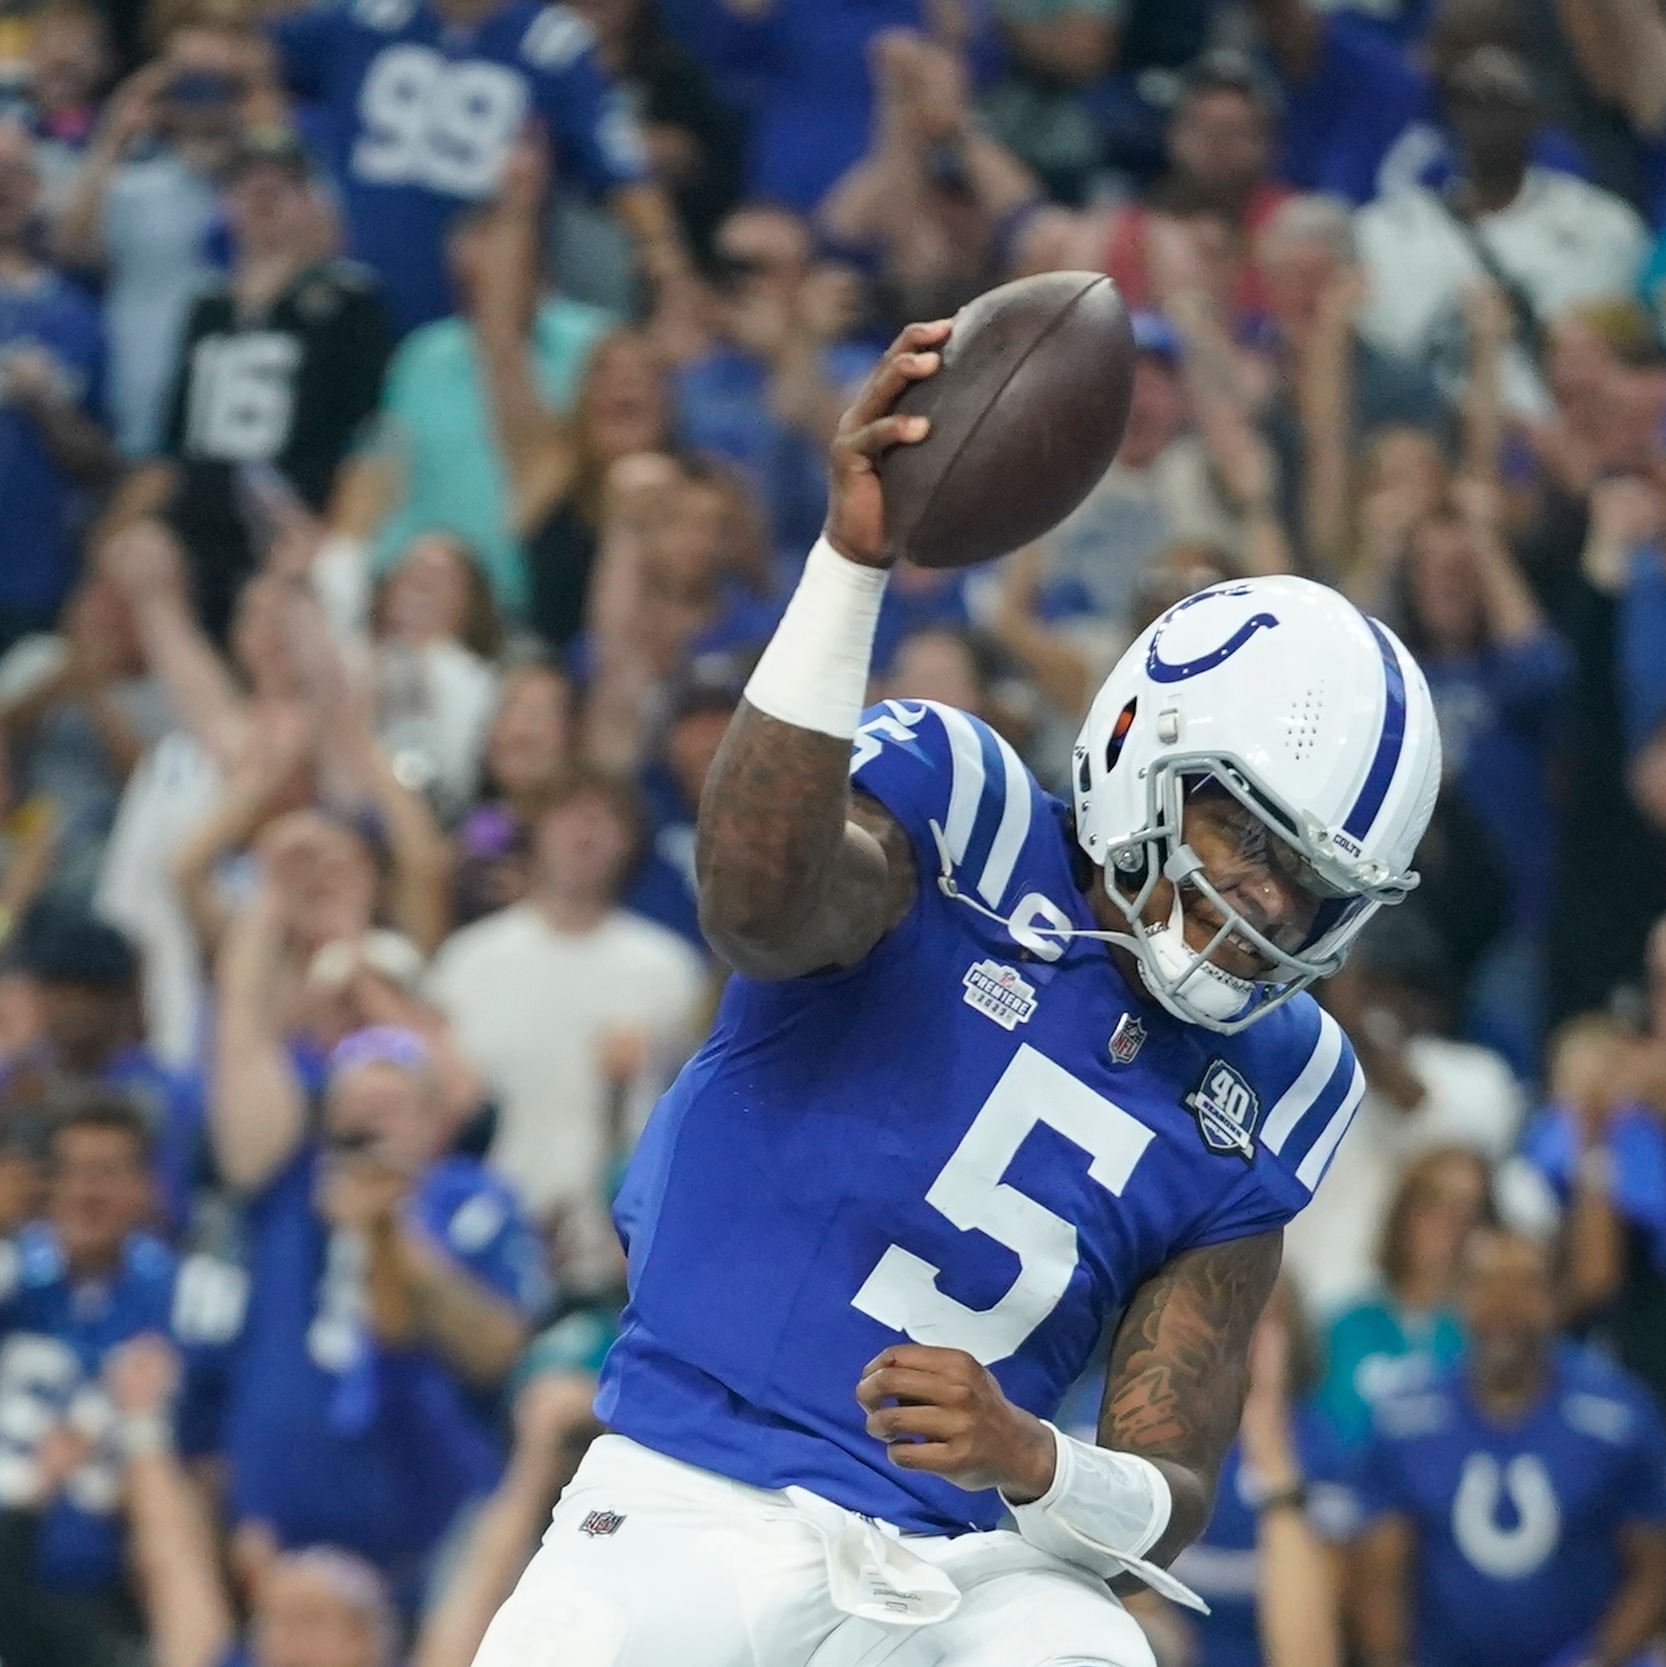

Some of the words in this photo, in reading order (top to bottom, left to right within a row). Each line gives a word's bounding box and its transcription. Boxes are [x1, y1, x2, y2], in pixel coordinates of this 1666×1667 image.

[351, 42, 529, 198] 99
[1333, 834, 1362, 858] COLTS
[1211, 1069, 1250, 1124] 40
[850, 1042, 1157, 1367] 5
